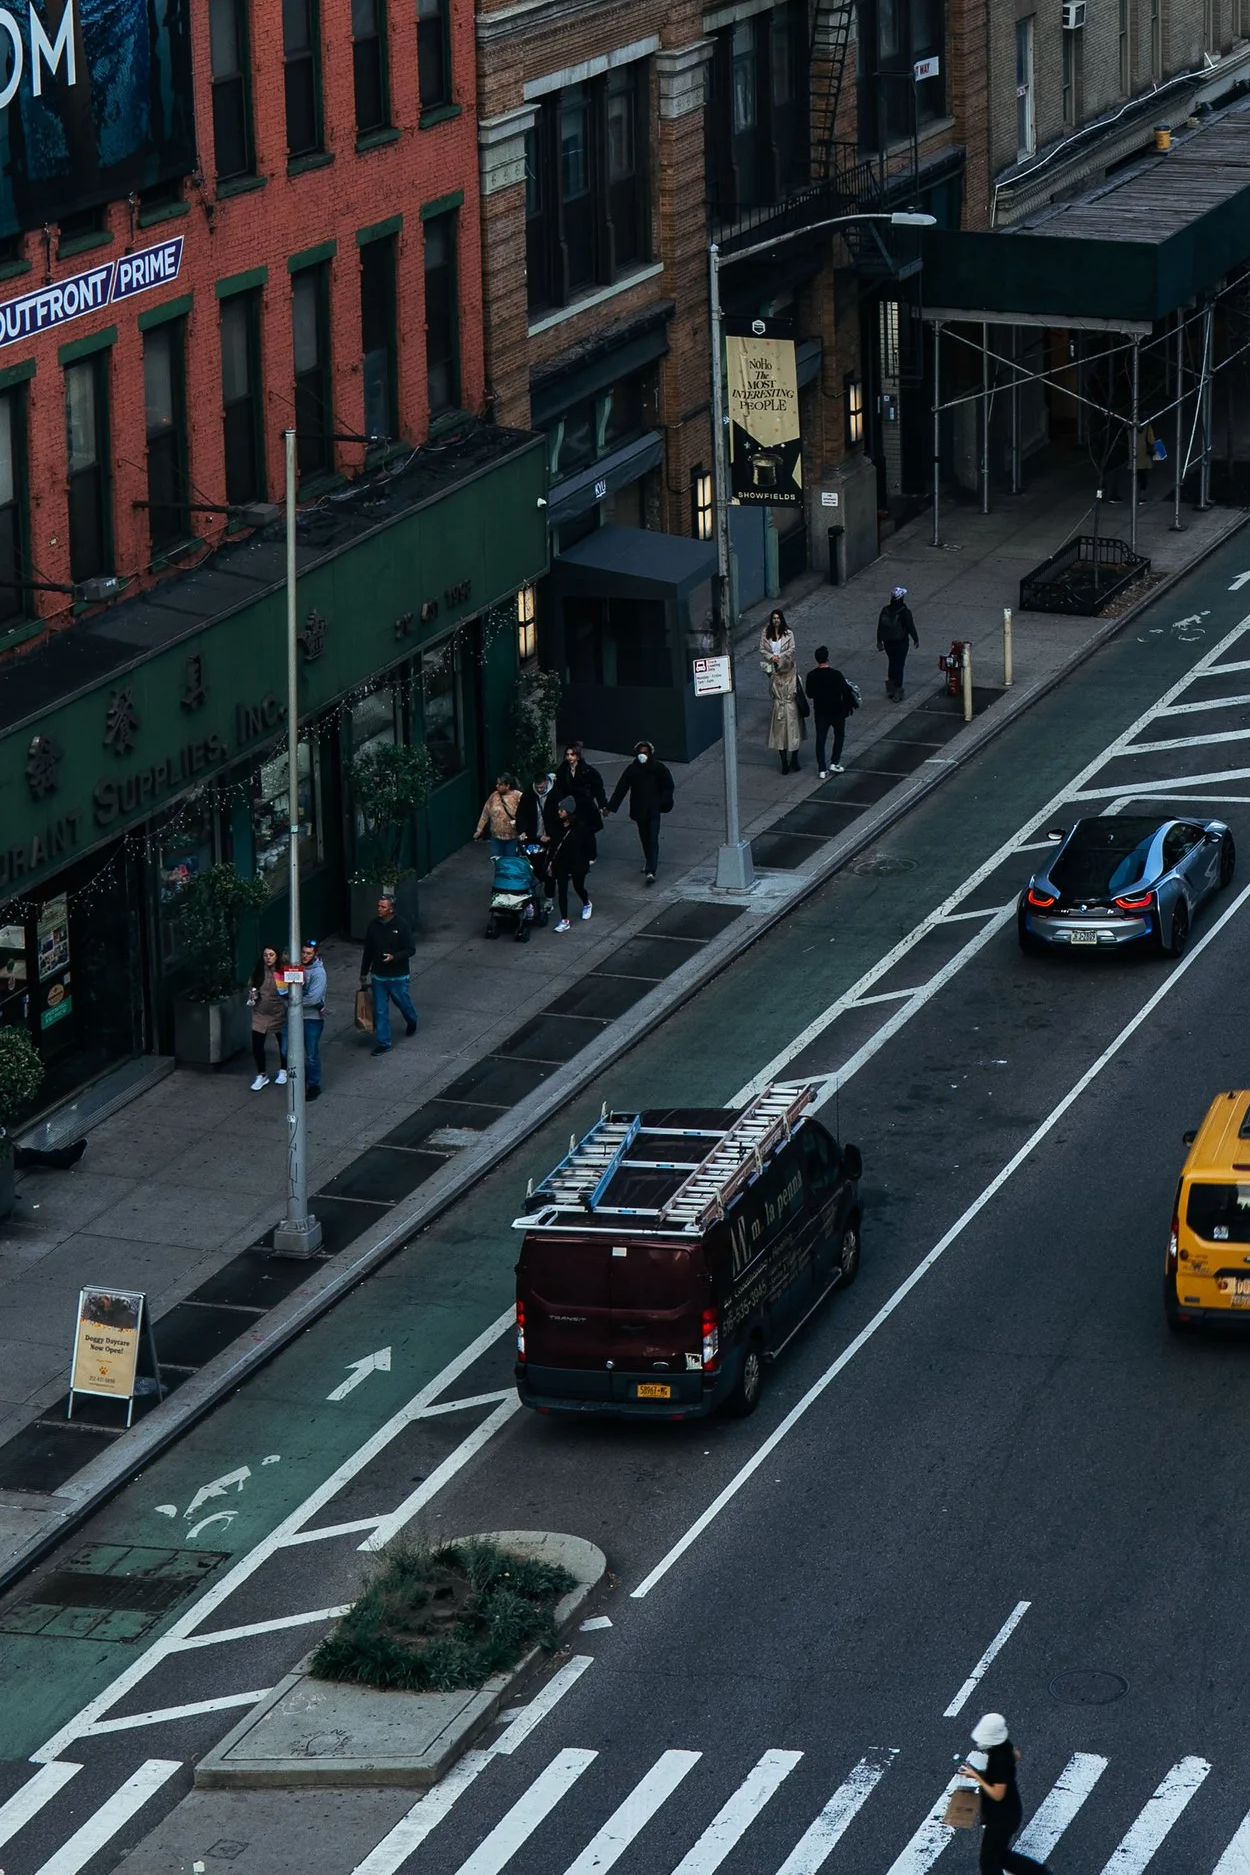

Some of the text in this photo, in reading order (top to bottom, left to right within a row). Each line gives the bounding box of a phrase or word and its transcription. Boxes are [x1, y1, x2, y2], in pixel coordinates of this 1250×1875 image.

[120, 246, 176, 293] PRIME
[749, 358, 772, 371] NoHo
[755, 371, 769, 380] The
[747, 380, 777, 389] MOST
[732, 389, 795, 399] INTERESTING
[740, 399, 787, 411] PEOPLE
[738, 491, 796, 501] SHOWFIELDS
[235, 695, 288, 746] INC.
[777, 1169, 803, 1219] penna
[549, 1314, 587, 1322] TRANSIT
[85, 1334, 130, 1347] Doggy Daycare
[90, 1343, 124, 1354] Now Open!
